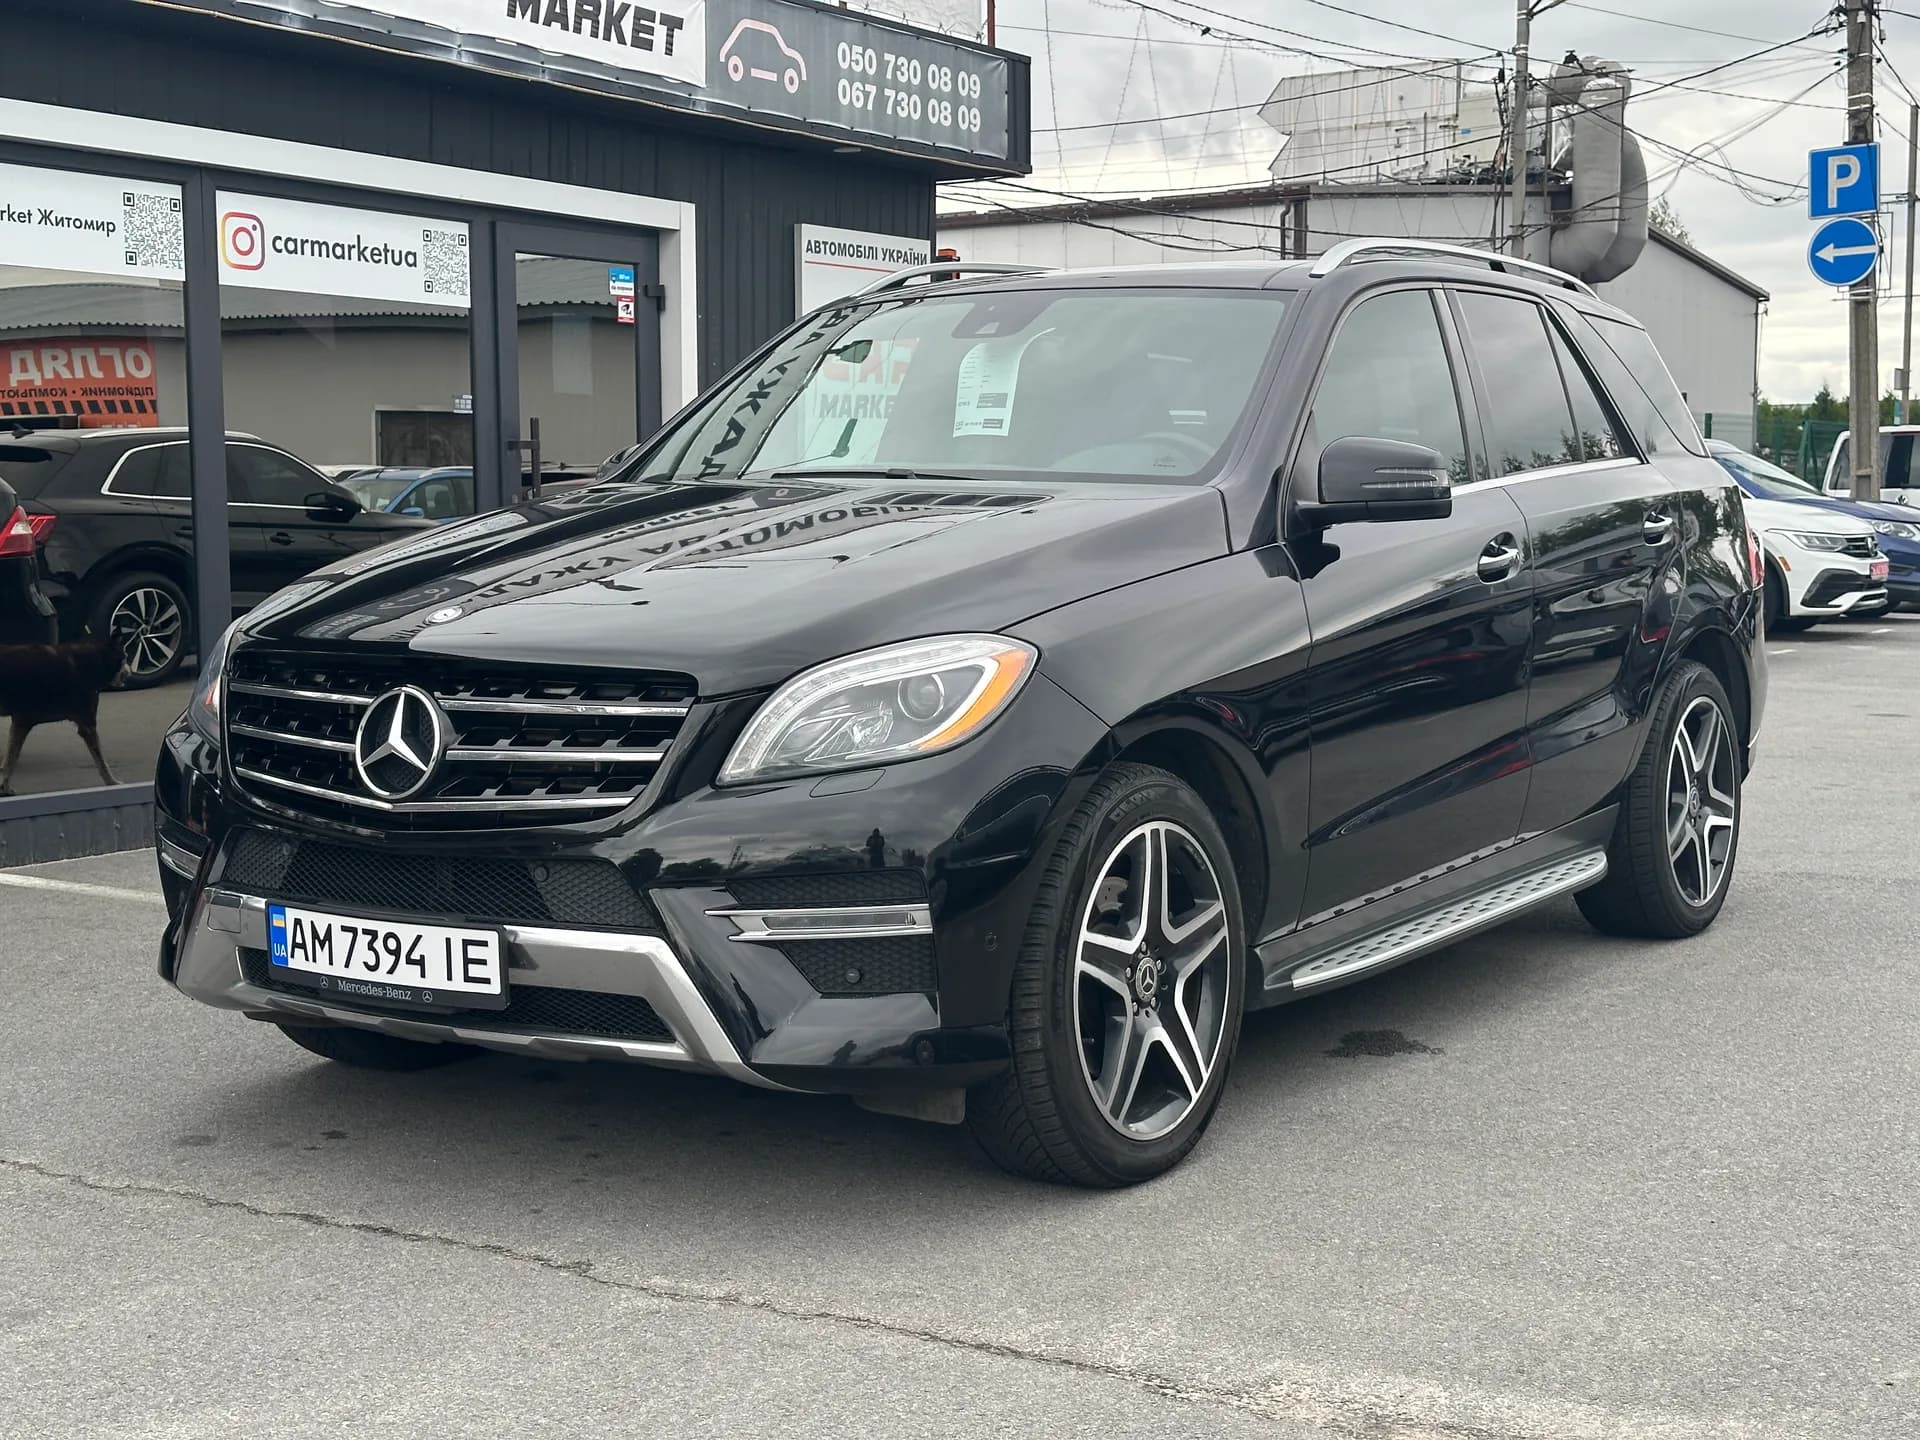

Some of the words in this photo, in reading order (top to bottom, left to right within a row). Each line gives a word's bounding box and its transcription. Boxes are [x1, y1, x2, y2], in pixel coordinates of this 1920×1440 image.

[837, 41, 877, 76] 050
[883, 52, 922, 86] 730
[927, 63, 952, 93] 08
[957, 70, 981, 99] 09
[837, 78, 877, 111] 067
[883, 88, 922, 121] 730
[927, 98, 952, 127] 08
[957, 105, 981, 133] 09
[1827, 154, 1861, 208] P
[37, 208, 117, 237] Житомир
[271, 234, 418, 268] carmarketua
[805, 239, 878, 261] АВТОМОБІЛІ
[881, 247, 928, 266] УКРАЇНИ
[273, 943, 288, 958] UA
[290, 917, 334, 966] AM
[340, 925, 426, 979] 7394
[445, 936, 492, 985] IE
[338, 979, 412, 1001] Mercedes-Benz
